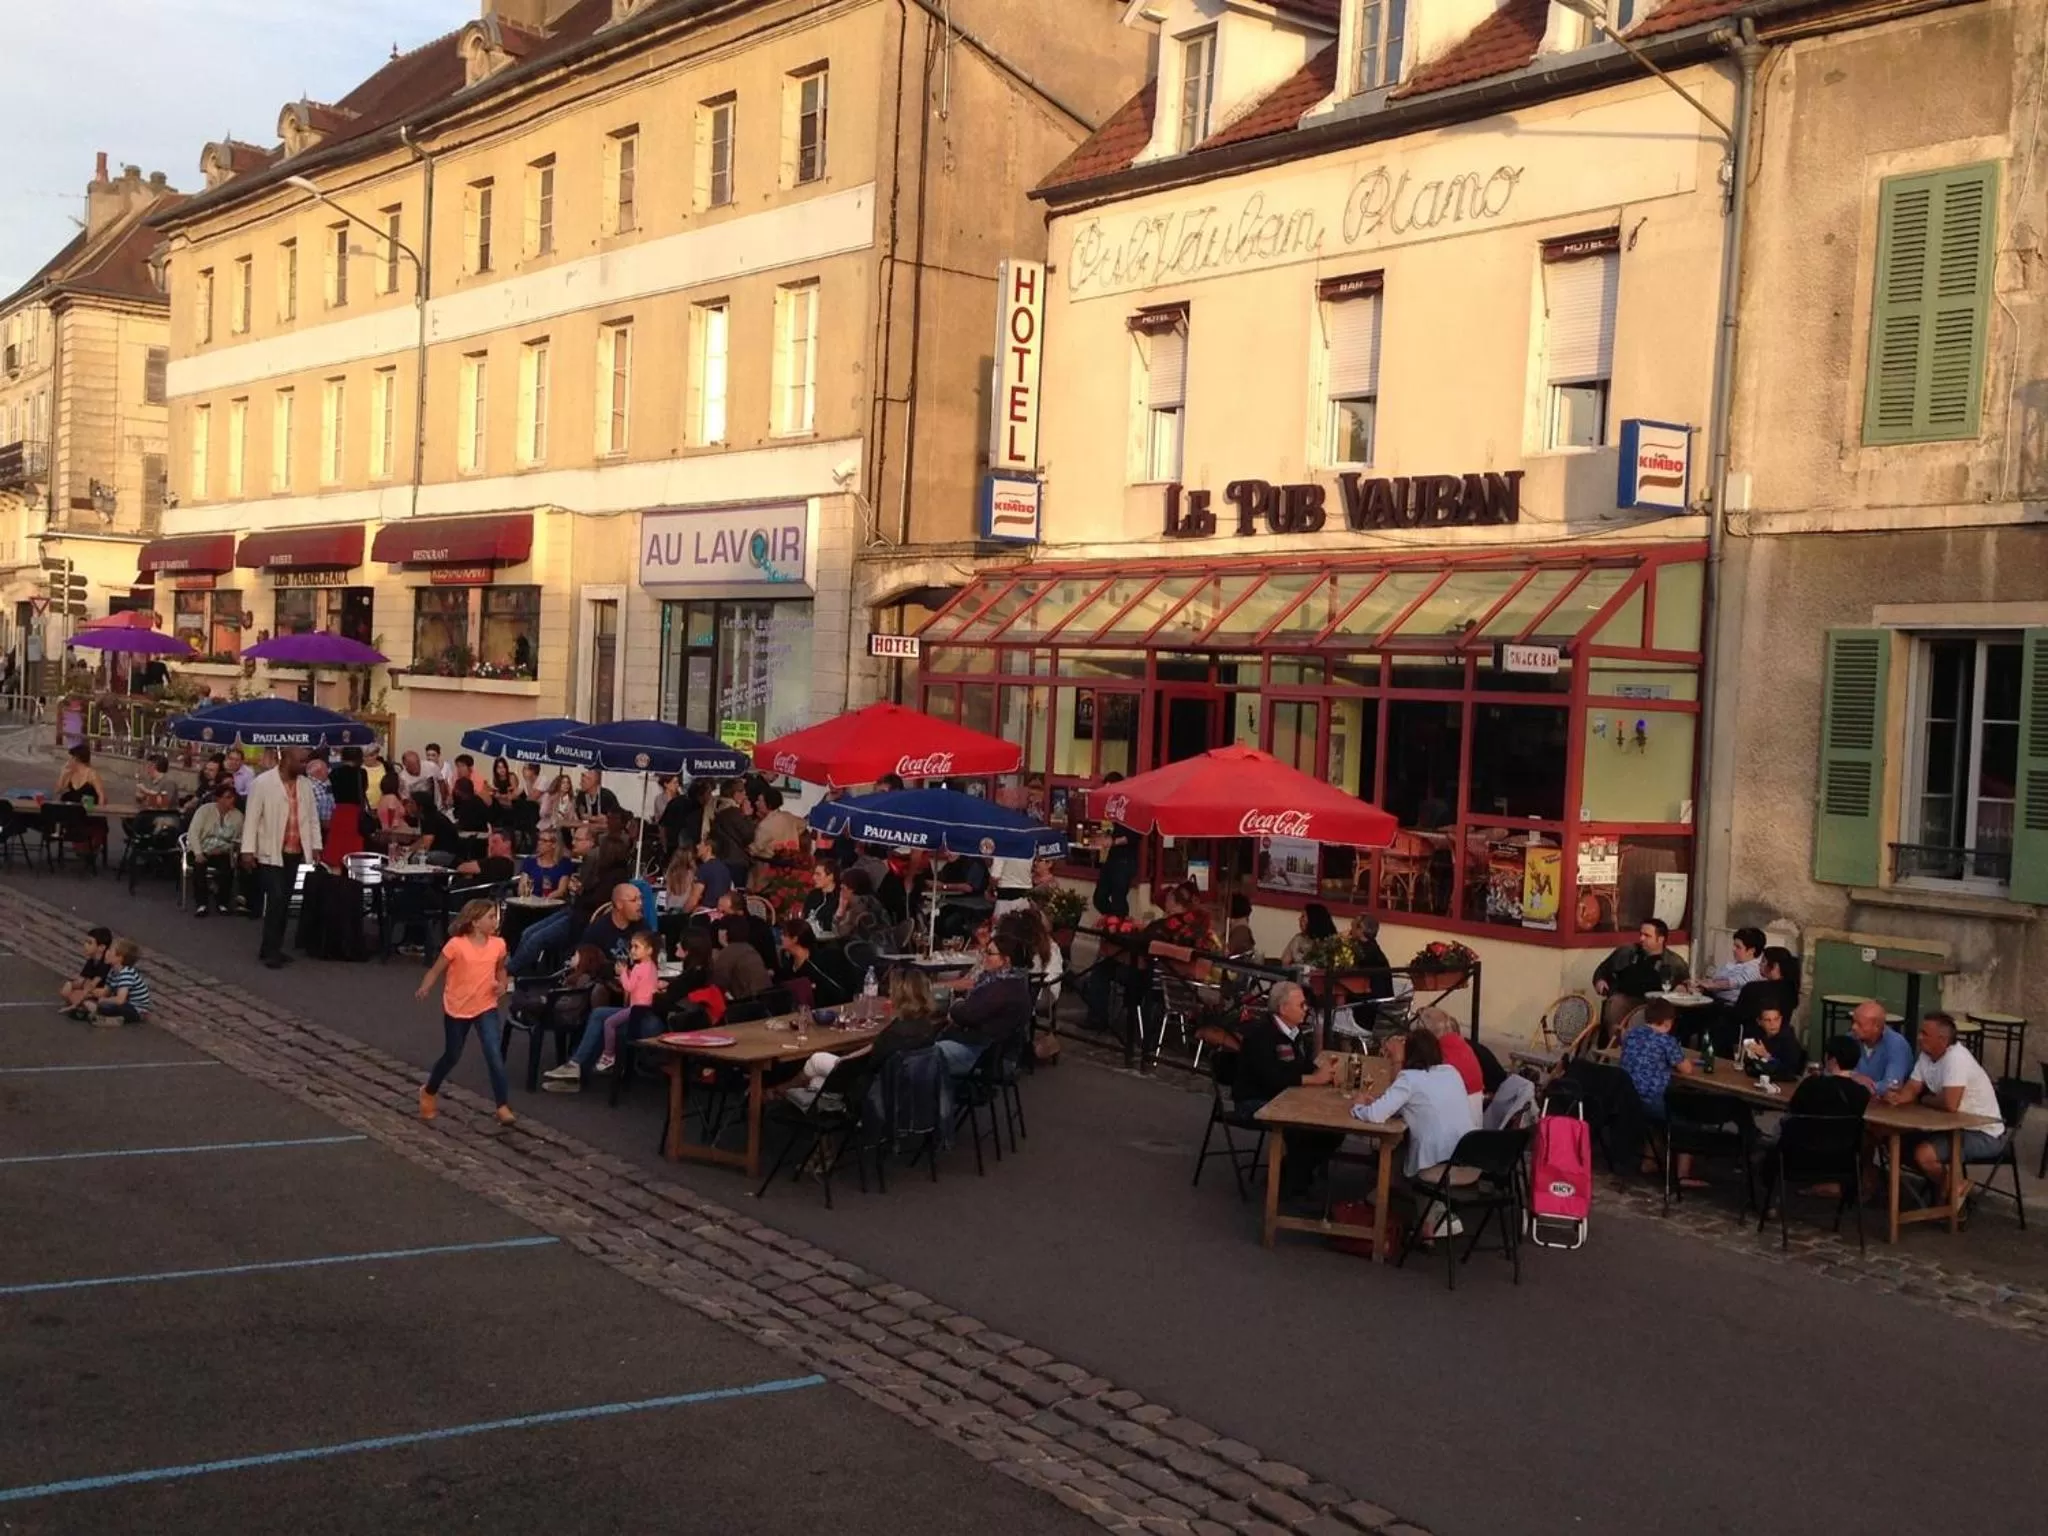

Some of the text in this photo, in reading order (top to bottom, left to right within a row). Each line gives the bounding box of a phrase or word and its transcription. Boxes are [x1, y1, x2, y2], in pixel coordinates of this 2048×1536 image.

[1008, 266, 1036, 462] HOTEL
[1639, 456, 1684, 472] KIMBO
[994, 502, 1035, 514] KIMBO
[1225, 479, 1326, 537] PUB
[1339, 470, 1525, 530] VAUBAN
[646, 526, 800, 569] AU LAVOIR
[875, 637, 917, 654] HOTEL
[253, 732, 310, 743] PAULANER
[517, 749, 549, 761] PAULA
[555, 744, 593, 760] PAULANER
[694, 758, 736, 770] PAULANER
[896, 752, 954, 776] Coca-Cola
[1239, 808, 1314, 836] Coca-Cola
[863, 824, 928, 845] PAULANER
